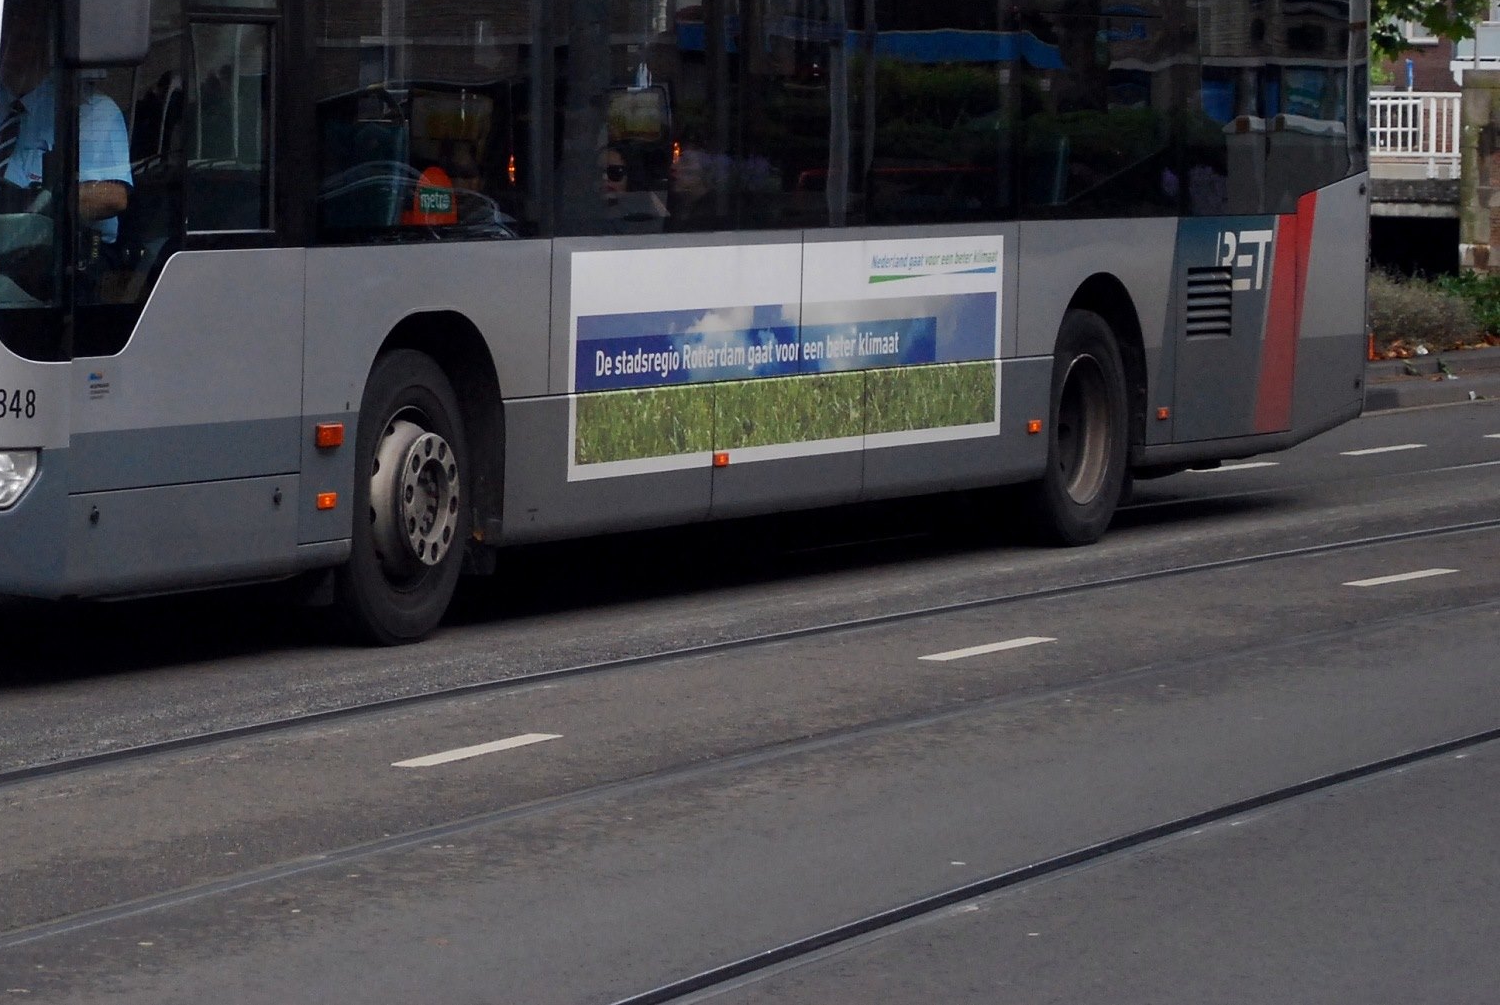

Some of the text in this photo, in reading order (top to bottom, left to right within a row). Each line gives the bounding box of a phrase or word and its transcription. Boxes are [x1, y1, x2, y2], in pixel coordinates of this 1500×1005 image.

[871, 253, 908, 268] Nederland
[595, 331, 900, 378] De stadsregio Rotterdam gaat voor een beter klimaat
